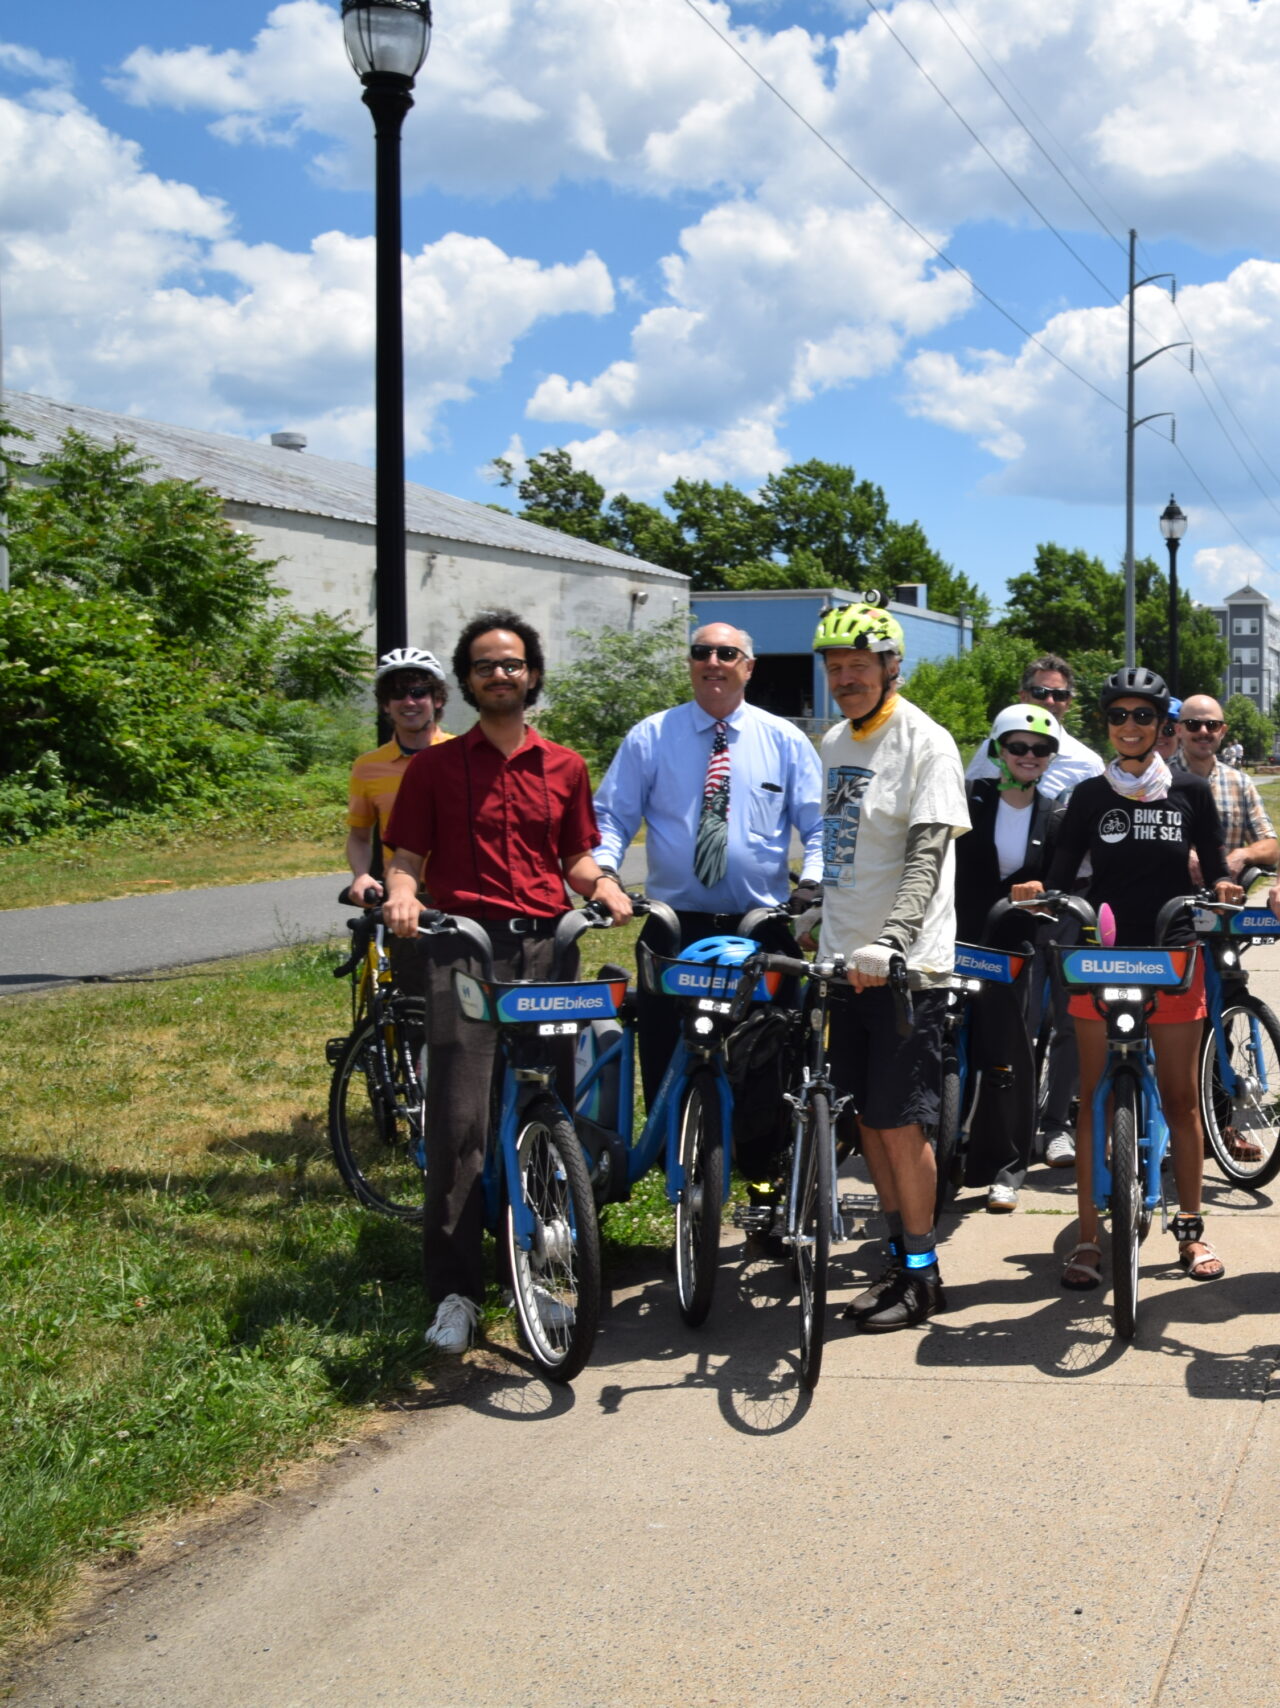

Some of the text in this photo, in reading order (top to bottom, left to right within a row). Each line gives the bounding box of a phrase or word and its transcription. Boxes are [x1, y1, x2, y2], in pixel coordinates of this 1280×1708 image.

[1134, 808, 1183, 827] BIKE TO
[1133, 825, 1183, 844] THE SEA
[954, 954, 1004, 974] UEbikes
[1081, 959, 1165, 975] BLUEbikes
[517, 995, 605, 1012] BLUEbikes
